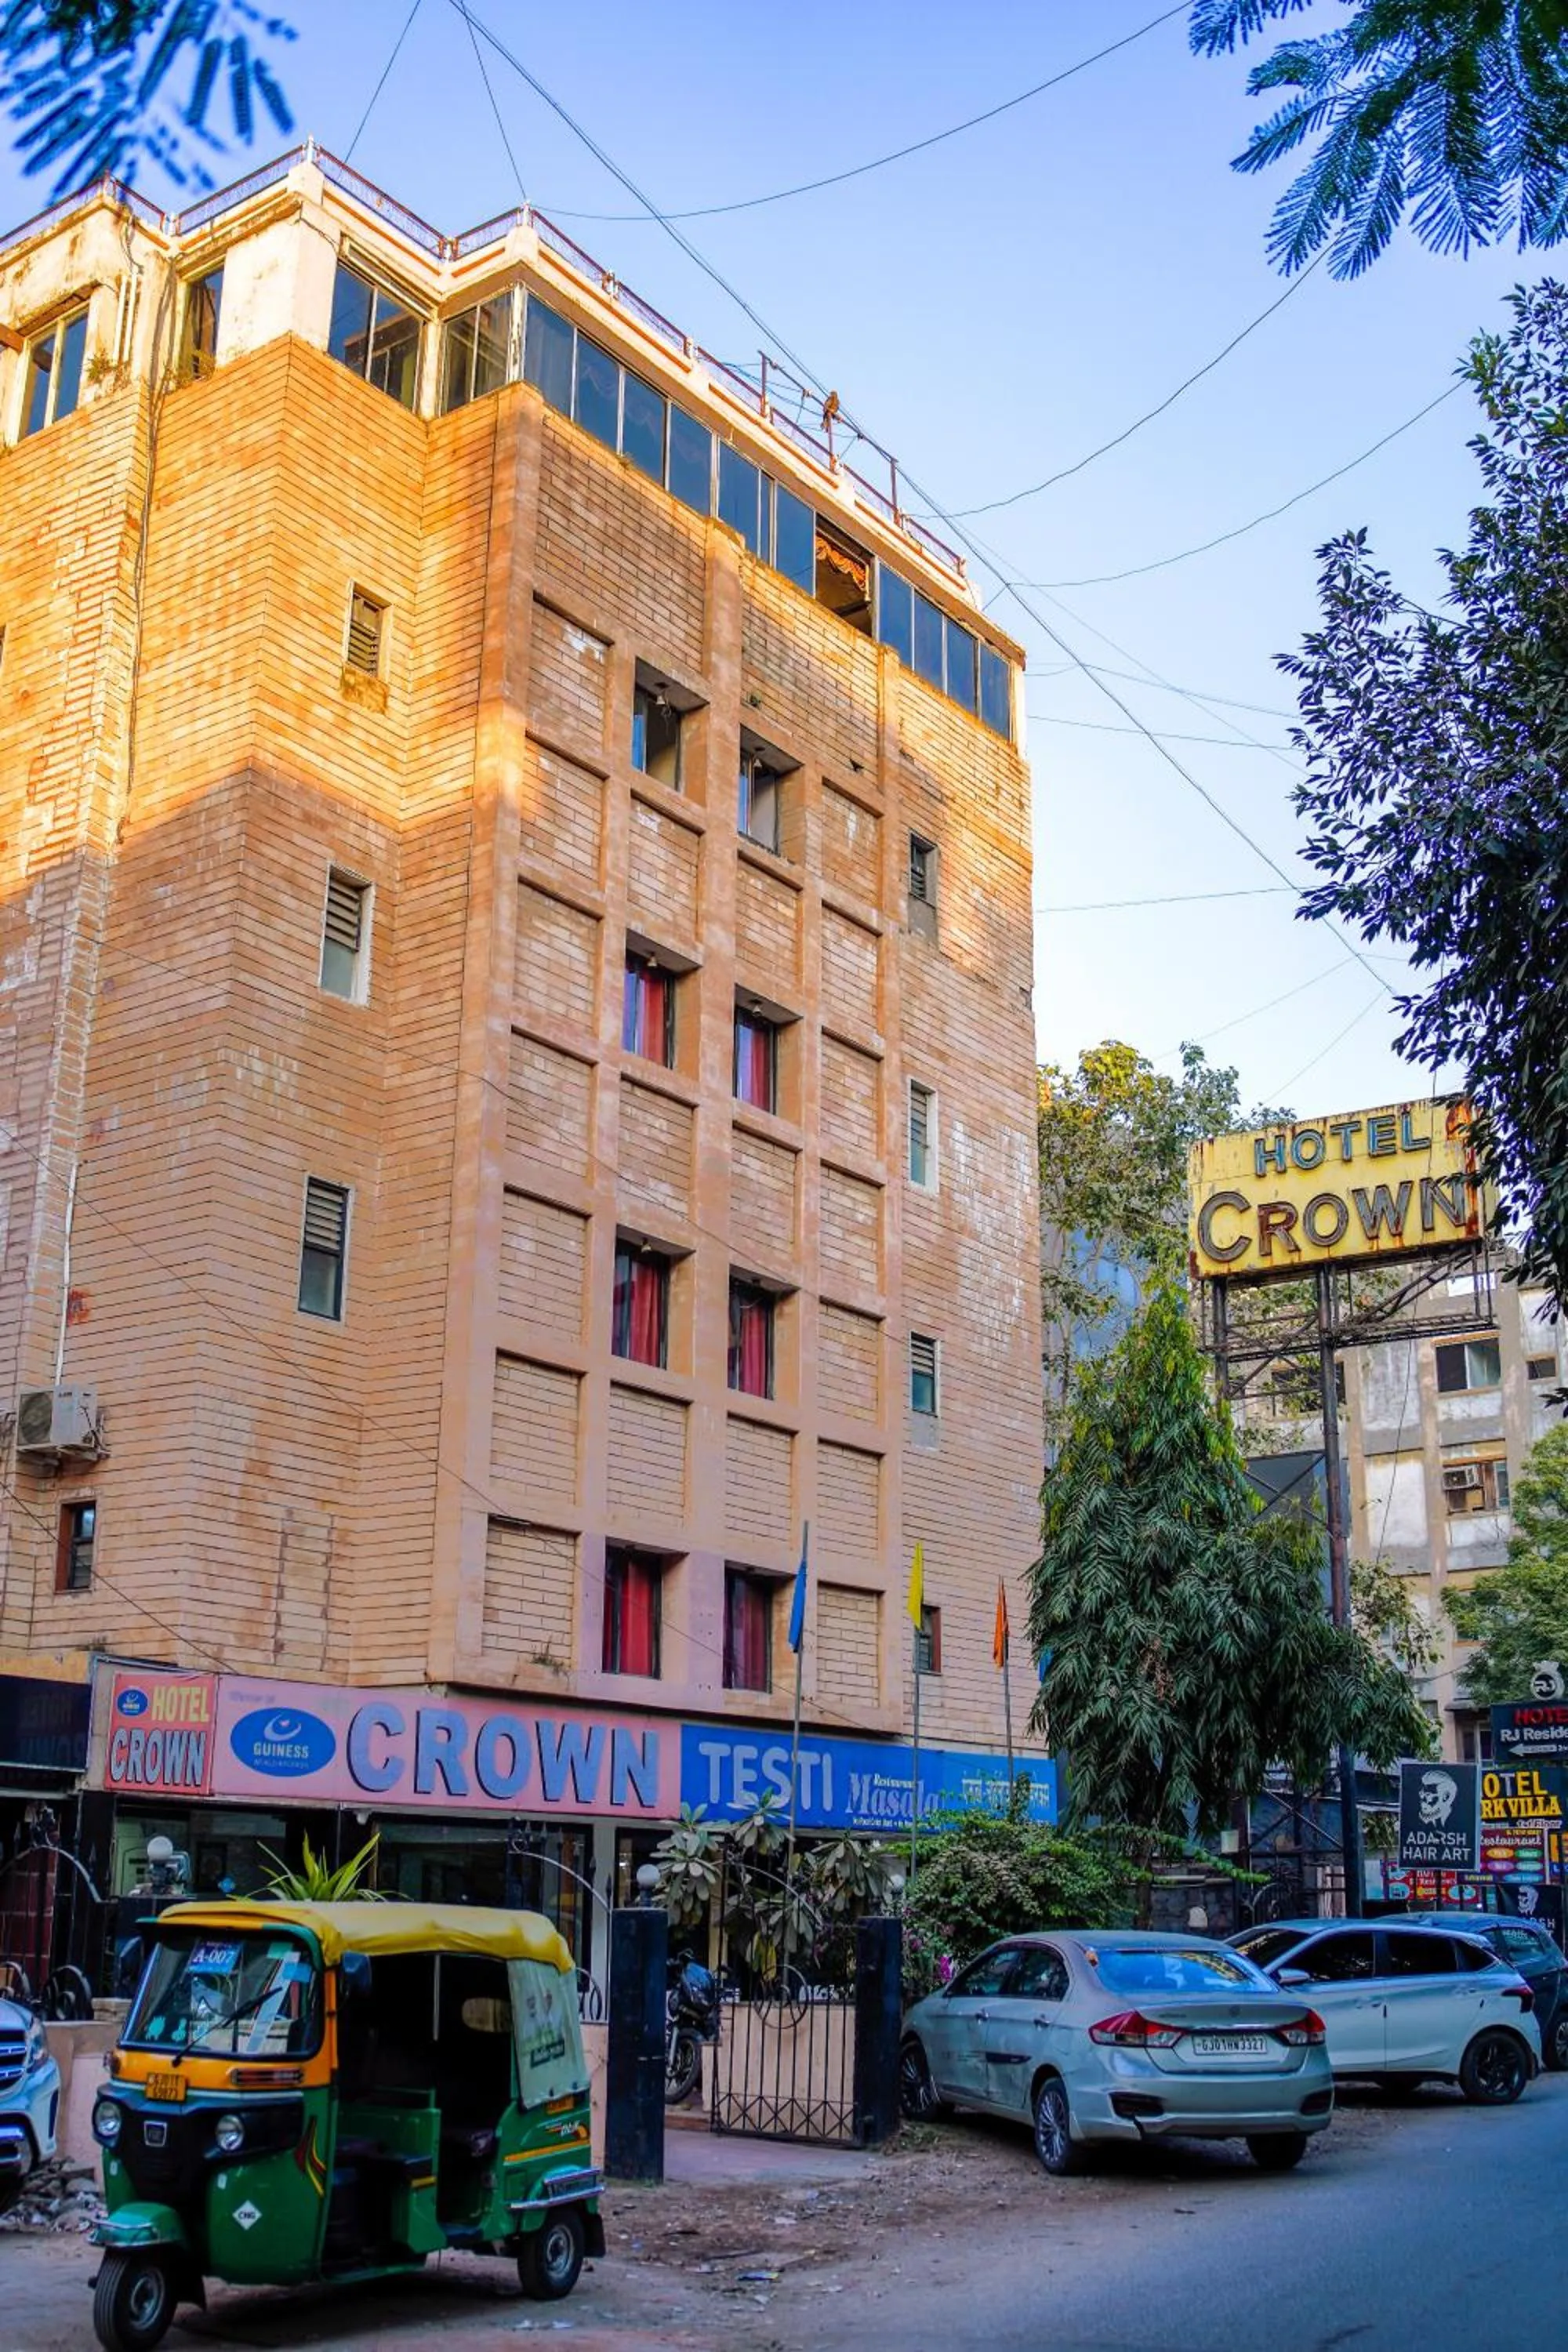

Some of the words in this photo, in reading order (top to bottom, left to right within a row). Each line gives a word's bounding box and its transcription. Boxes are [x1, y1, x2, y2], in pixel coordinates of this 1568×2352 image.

[1254, 1110, 1431, 1176] HOTEL
[1198, 1178, 1467, 1262] CROWN
[151, 1686, 209, 1722] HOTEL
[1514, 1707, 1568, 1726] HOTE
[1501, 1728, 1520, 1742] RJ
[1523, 1726, 1568, 1741] Reside
[111, 1728, 206, 1787] CROWN
[253, 1741, 310, 1759] GUINESS
[347, 1701, 660, 1809] CROWN
[699, 1741, 833, 1812] TESTI
[1483, 1771, 1548, 1798] OTEL
[845, 1773, 940, 1819] Masala
[1480, 1798, 1508, 1820] RK
[1506, 1795, 1563, 1818] VILLA
[1406, 1831, 1467, 1846] ADARSH
[1403, 1846, 1437, 1861] HAIR
[1442, 1847, 1472, 1862] ART
[193, 1947, 235, 1963] A-007
[238, 2210, 256, 2220] CNG
